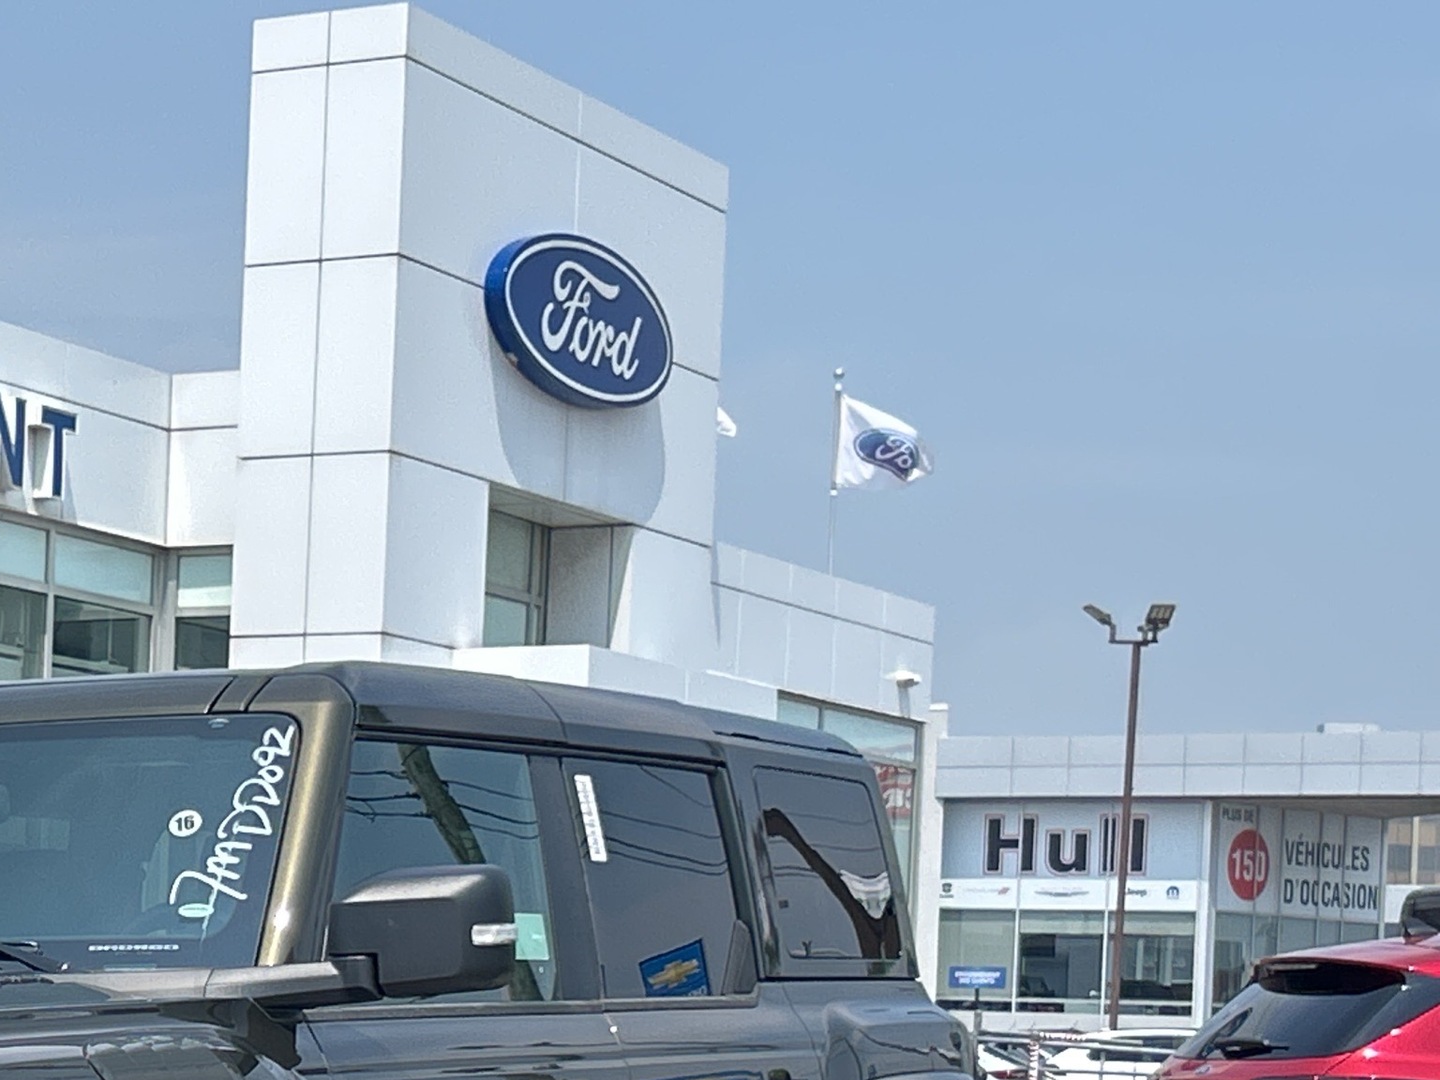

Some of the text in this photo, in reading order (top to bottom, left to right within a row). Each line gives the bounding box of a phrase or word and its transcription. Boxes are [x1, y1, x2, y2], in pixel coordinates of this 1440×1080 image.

[540, 260, 643, 381] Ford
[175, 815, 196, 832] 16
[984, 816, 1148, 874] Hull
[1231, 849, 1267, 882] 150
